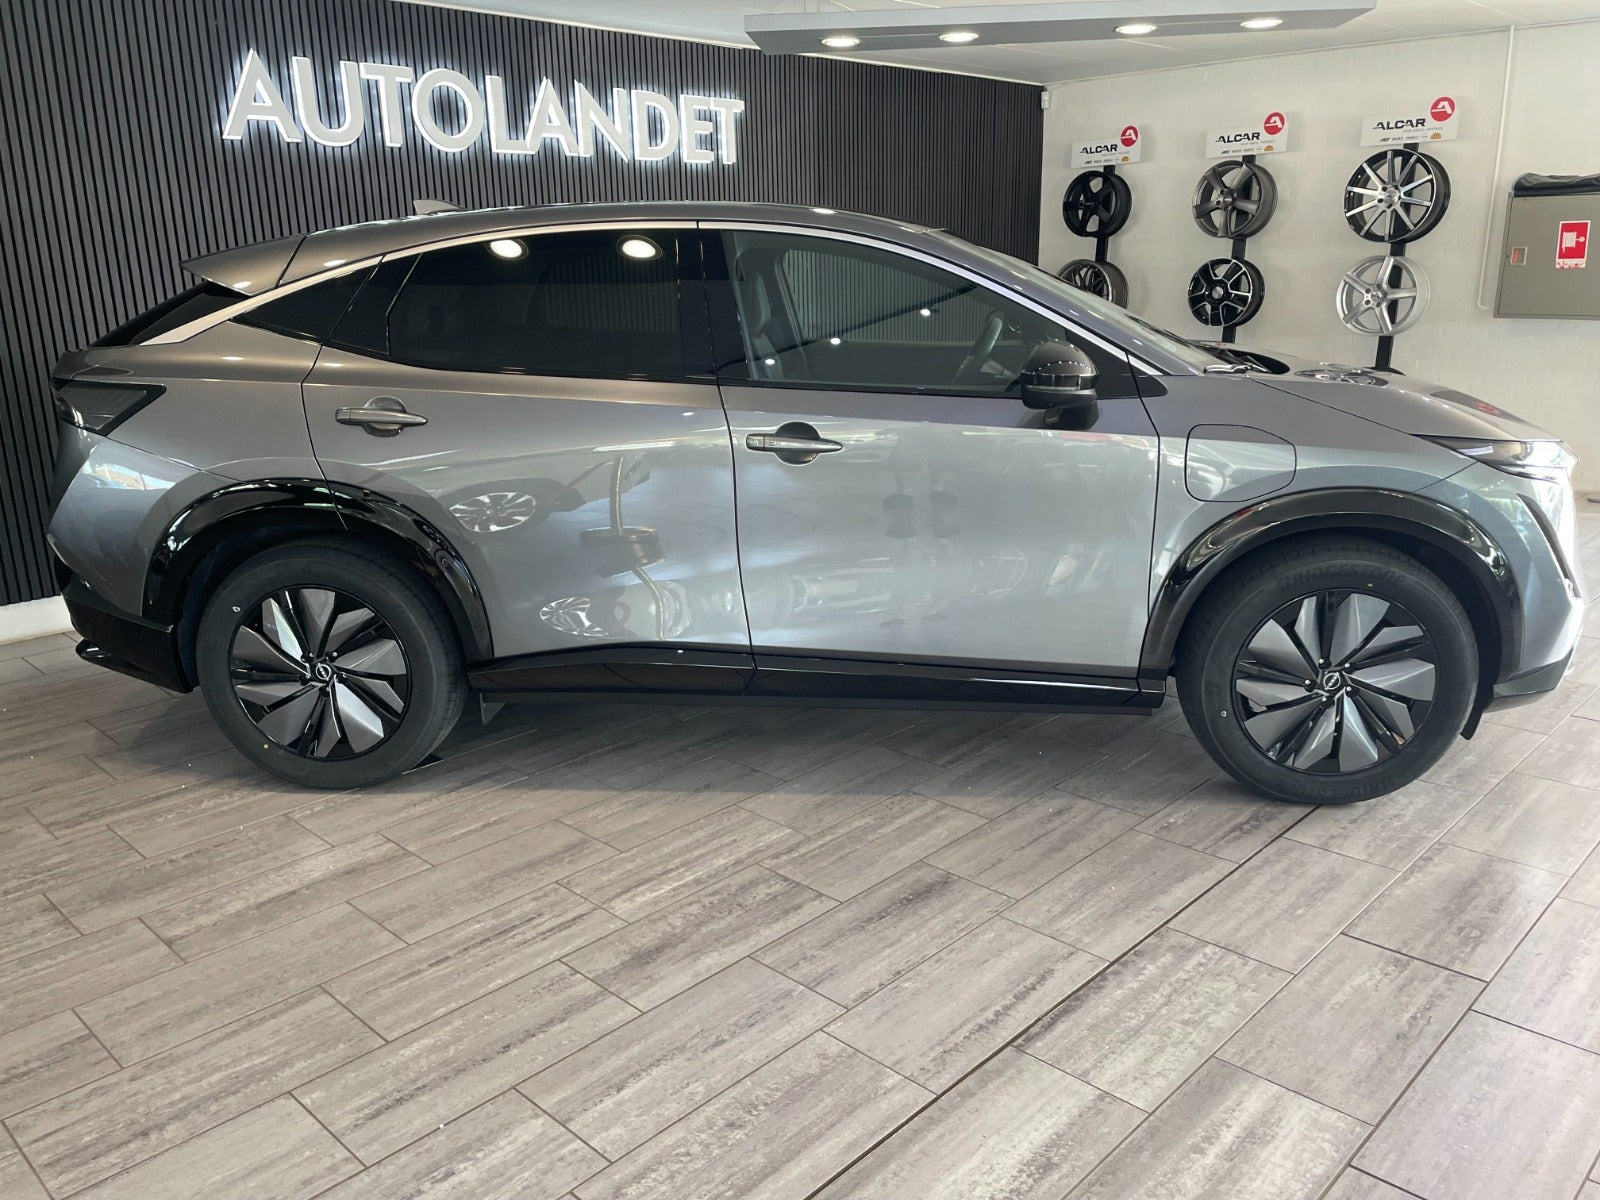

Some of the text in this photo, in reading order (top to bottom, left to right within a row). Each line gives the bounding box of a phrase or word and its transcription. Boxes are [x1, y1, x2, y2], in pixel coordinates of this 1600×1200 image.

[222, 48, 745, 165] AUTOLANDET
[1373, 118, 1426, 130] ALCAR
[1215, 132, 1261, 143] ALCAR
[1080, 143, 1118, 154] ALCAR
